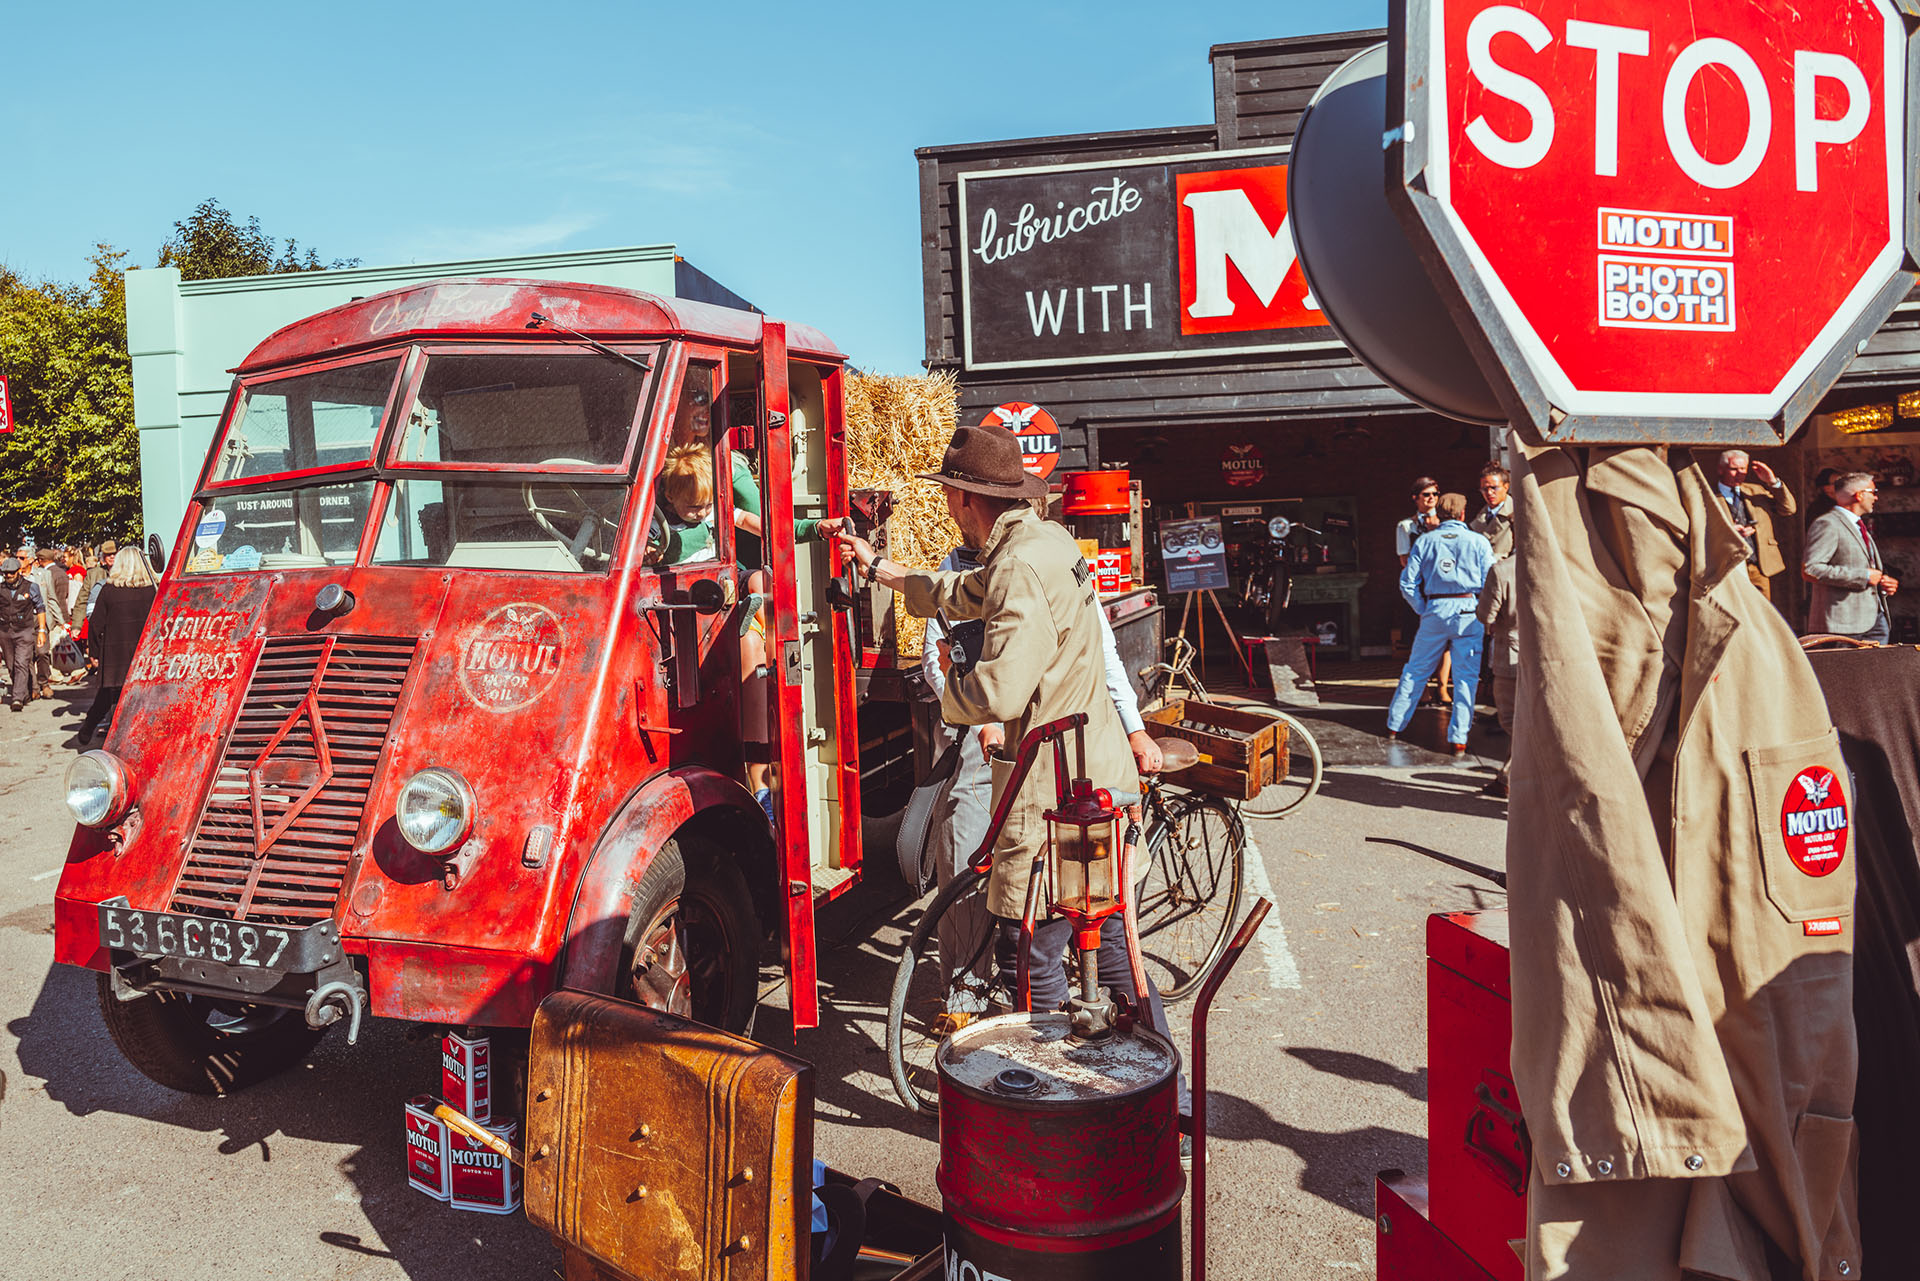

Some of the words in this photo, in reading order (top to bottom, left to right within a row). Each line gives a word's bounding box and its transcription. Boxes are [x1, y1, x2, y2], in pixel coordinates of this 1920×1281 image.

[1465, 5, 1871, 193] STOP
[973, 176, 1143, 265] lubricate
[1607, 215, 1725, 250] MOTUL
[1605, 264, 1725, 297] PHOTO
[1025, 282, 1153, 337] WITH
[1606, 290, 1727, 323] BOOTH
[1222, 459, 1263, 471] MOTUL
[236, 501, 257, 511] JUST
[260, 499, 293, 509] AROUND
[319, 496, 351, 506] ORNER
[1098, 567, 1120, 575] MOTUL
[159, 615, 233, 640] SERVICE
[465, 641, 556, 675] MOTUL
[483, 674, 529, 688] MOTOR
[488, 689, 513, 701] OIL
[1786, 806, 1847, 836] MOTUL
[442, 1051, 466, 1081] MOTUL
[408, 1129, 440, 1157] MOTUL
[451, 1149, 502, 1169] MOTUL
